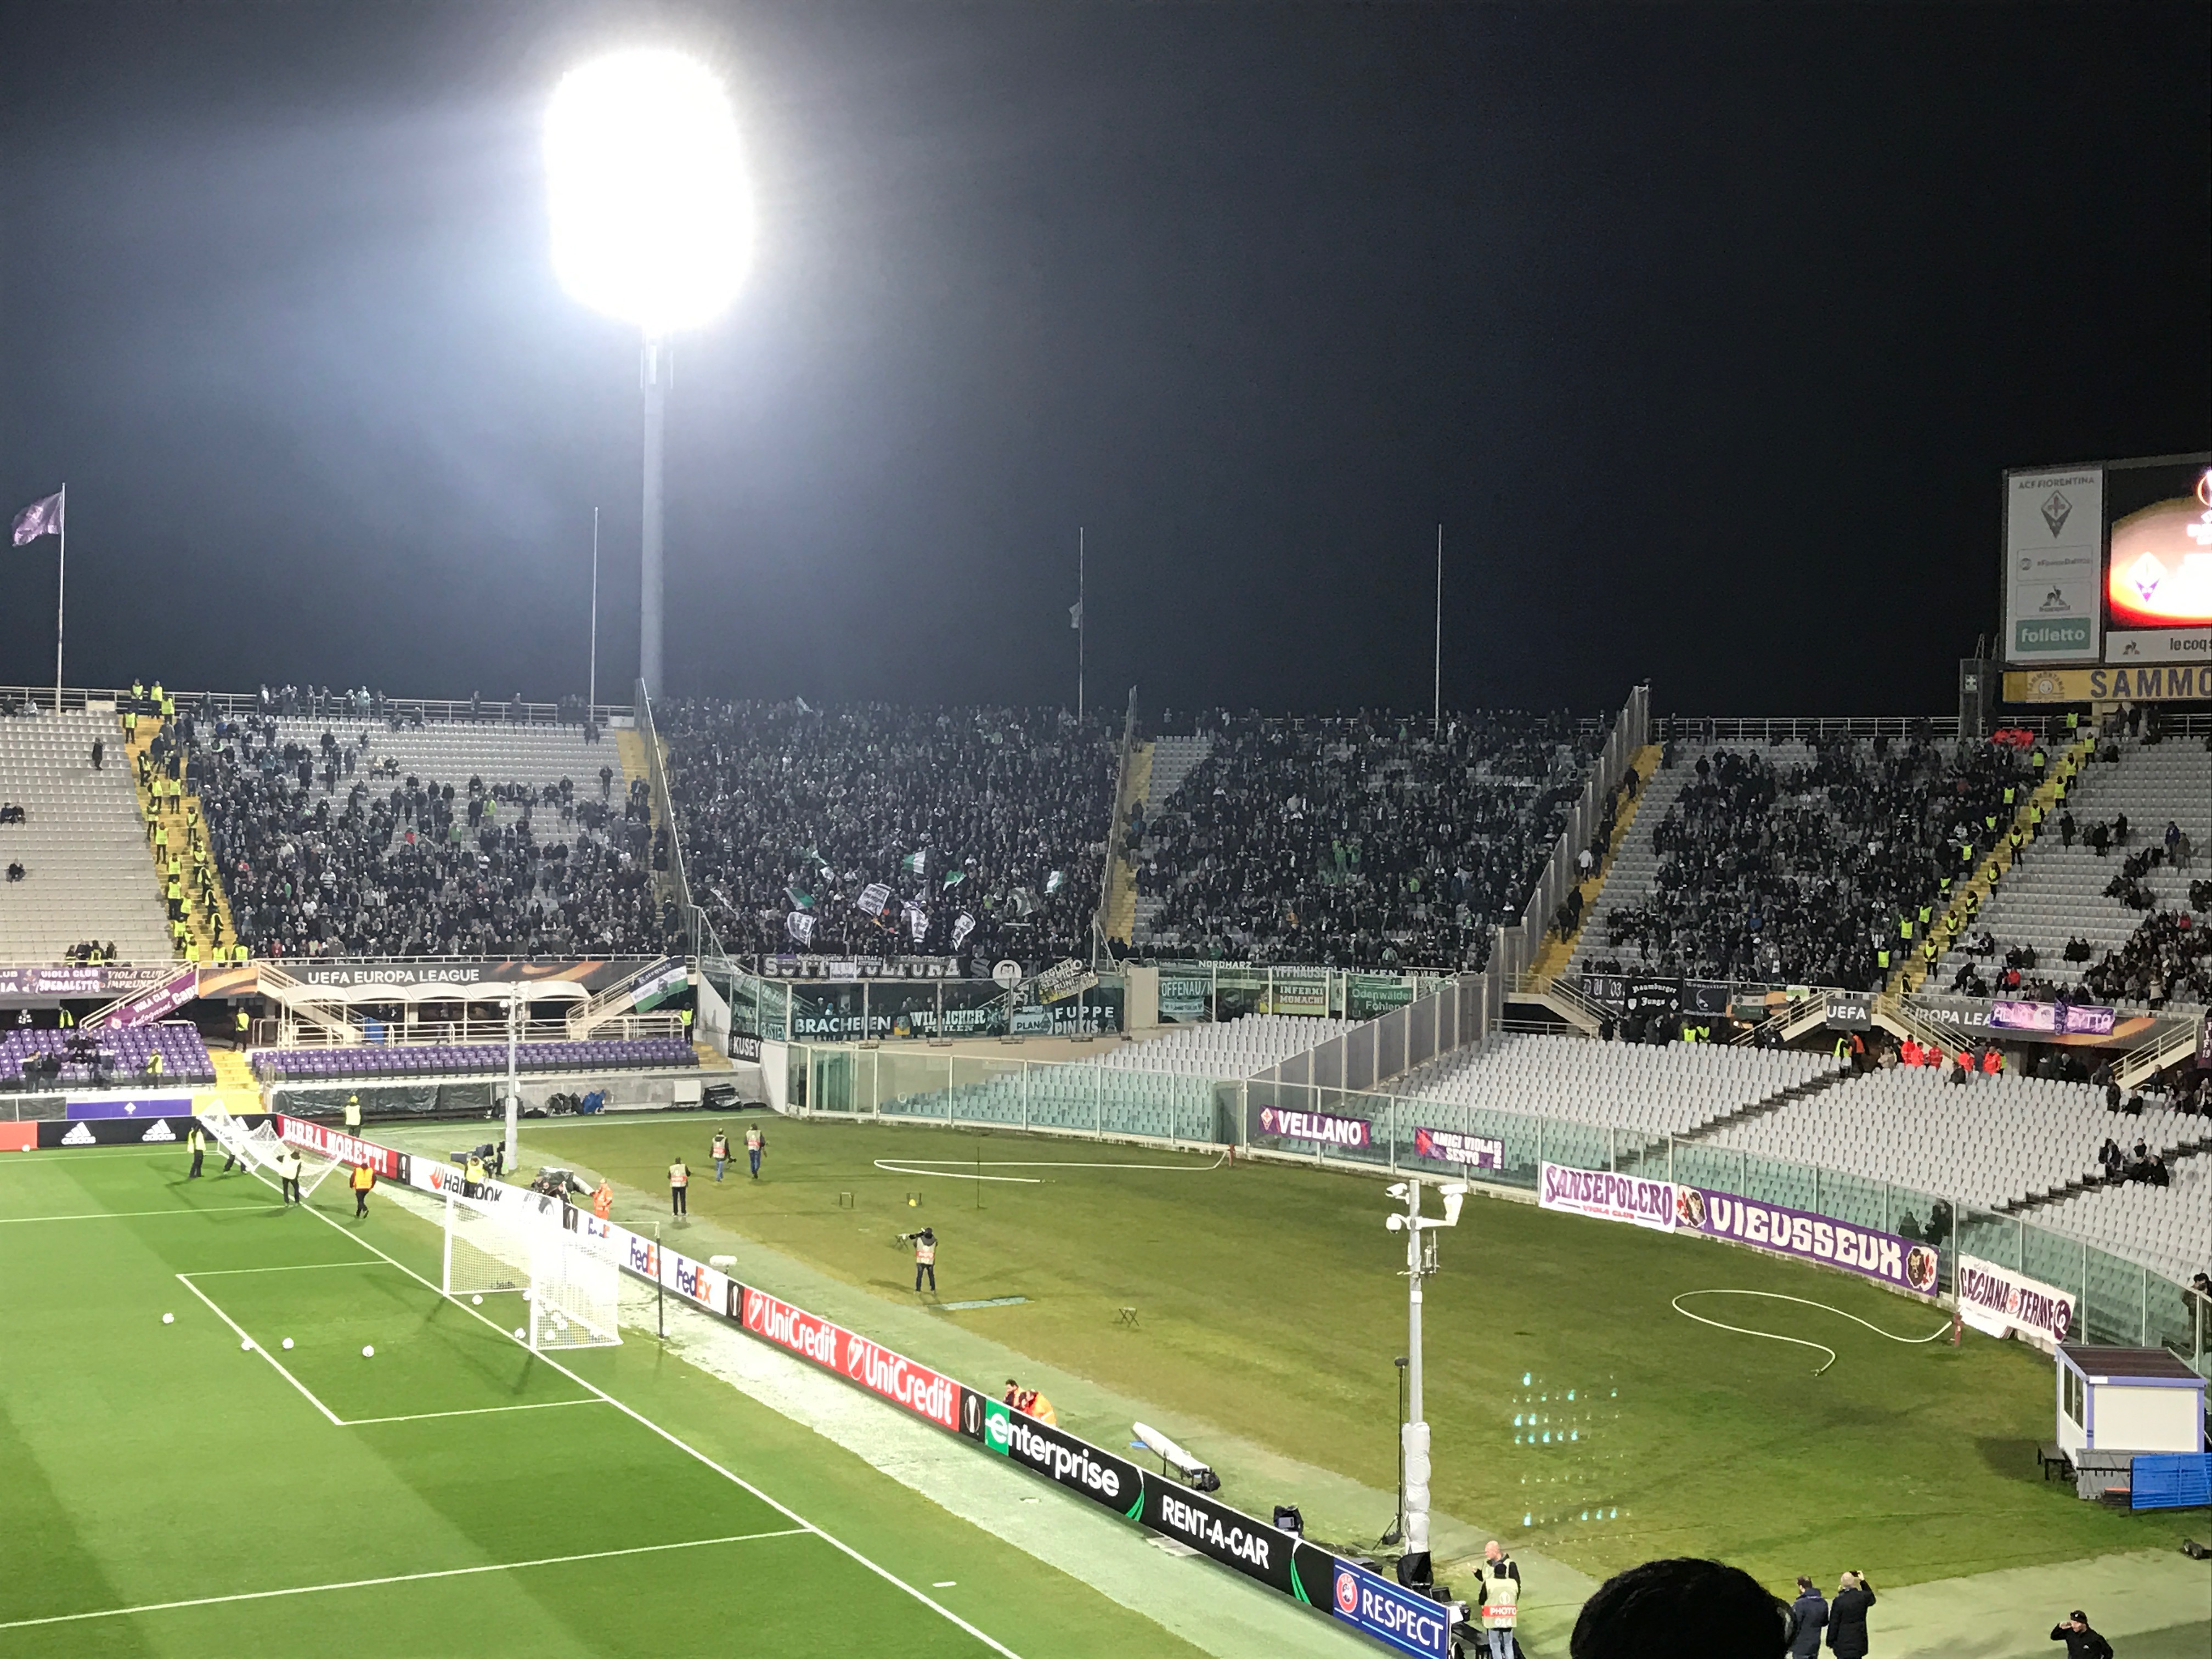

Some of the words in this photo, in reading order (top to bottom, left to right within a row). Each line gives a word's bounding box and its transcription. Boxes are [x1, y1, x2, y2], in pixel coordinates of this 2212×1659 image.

[2038, 477, 2095, 488] FIORENTINA
[2022, 628, 2085, 643] folletto
[2170, 637, 2181, 650] le
[2183, 640, 2207, 652] coq
[41, 969, 70, 978] VIOLA
[72, 969, 99, 978] CLUB
[108, 970, 138, 979] VIOLA
[1199, 960, 1252, 969] NORDHARZ
[308, 972, 350, 984] UEFA
[354, 970, 415, 983] EUROPA
[419, 969, 479, 981] LEAGUE
[1826, 1006, 1866, 1020] UEFA
[795, 1016, 891, 1033] BRACHEEN
[733, 1036, 760, 1058] KUSEY
[1278, 1110, 1362, 1145] VELLANO
[284, 1118, 323, 1149] BIRRA
[326, 1131, 387, 1173] MORETTI
[1432, 1131, 1462, 1148] AMICI
[1464, 1136, 1494, 1154] VIOLA
[1446, 1147, 1479, 1165] SESTO
[1545, 1165, 1673, 1226] SANSEPOLCRO
[1583, 1205, 1610, 1216] VIOLA
[1612, 1210, 1635, 1220] CLUB
[1711, 1197, 1902, 1279] VIEUSSEUX
[676, 1257, 712, 1305] FedEx
[2016, 1288, 2054, 1331] TERME
[764, 1301, 837, 1368] UniCredit
[864, 1347, 952, 1425] UniCredit
[985, 1413, 1120, 1497] enterprise
[1162, 1494, 1269, 1570] RENT-A-CAR
[1362, 1588, 1443, 1650] RESPECT
[1490, 1606, 1516, 1616] PHOTO
